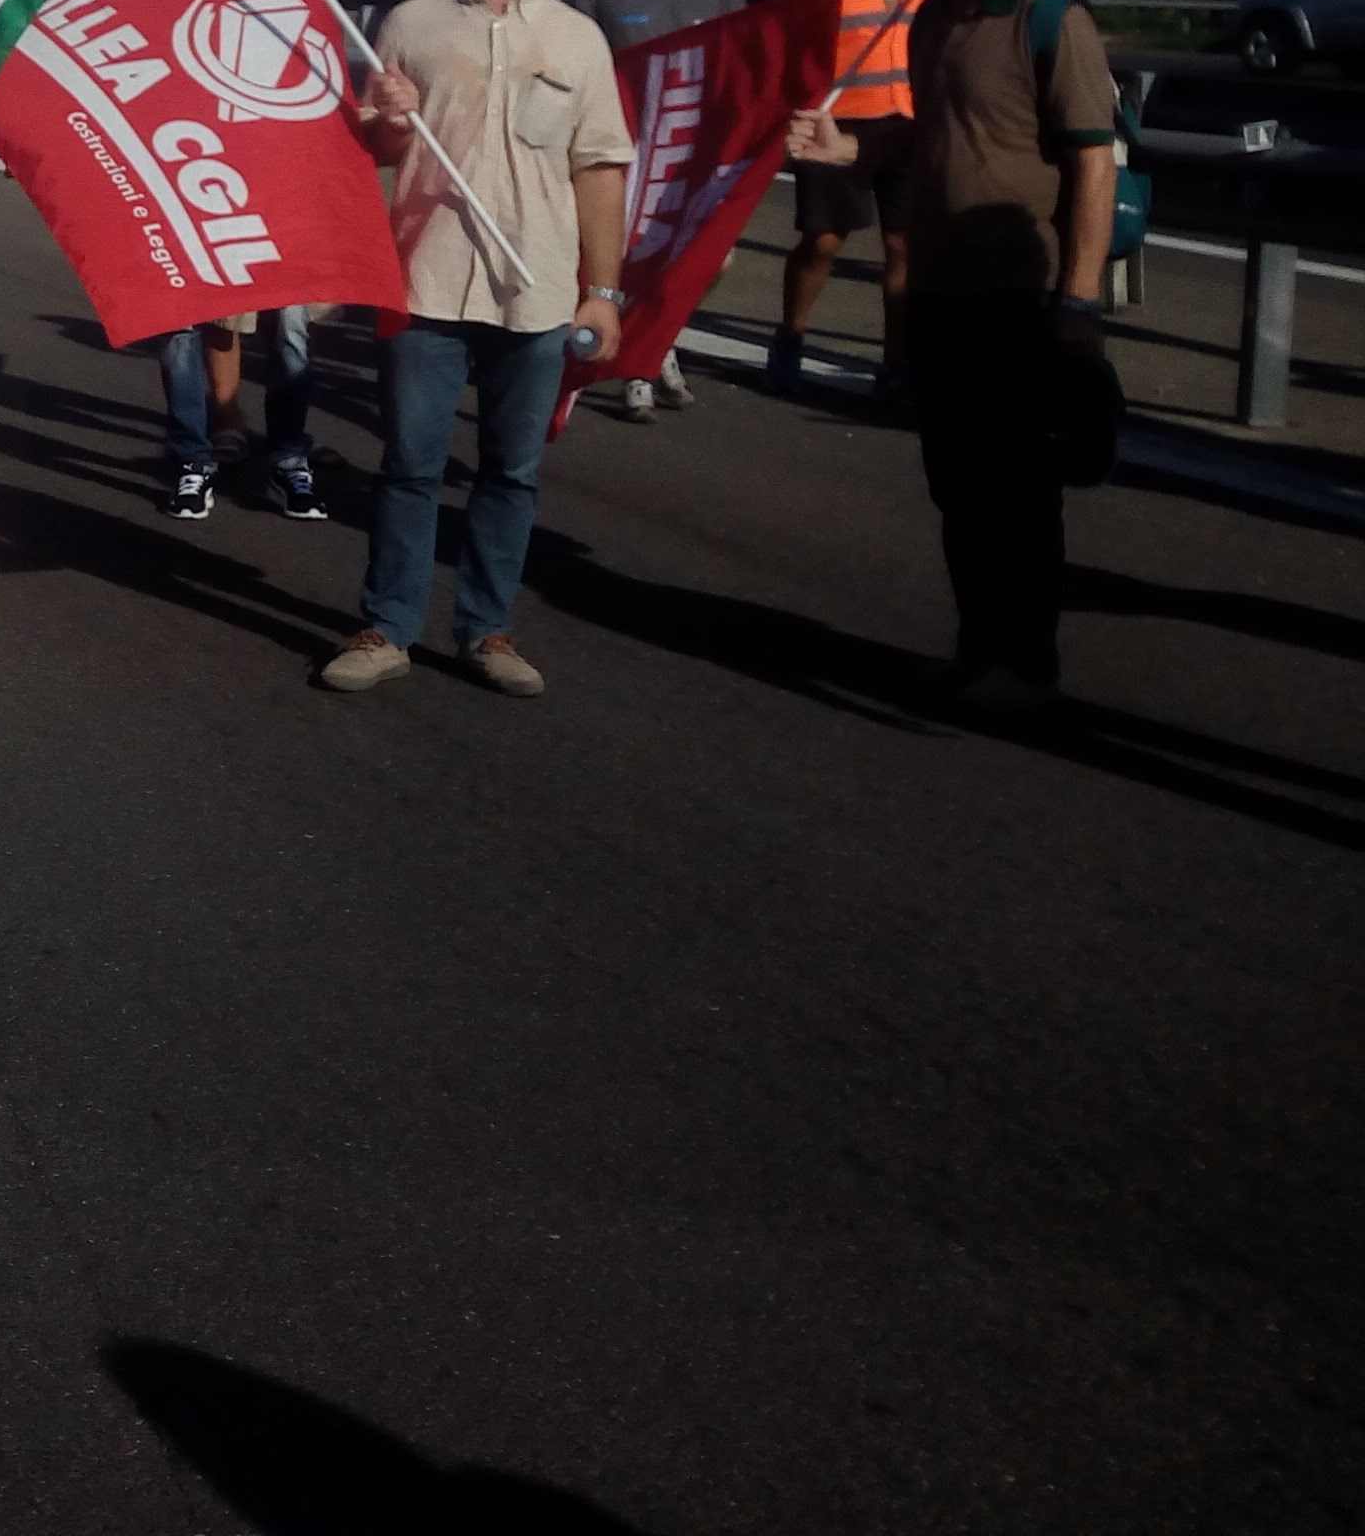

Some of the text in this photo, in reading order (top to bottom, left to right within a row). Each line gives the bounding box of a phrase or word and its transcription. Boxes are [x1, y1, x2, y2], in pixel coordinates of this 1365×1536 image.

[67, 111, 186, 288] Costruzioni e Legno
[152, 119, 282, 285] CGIL
